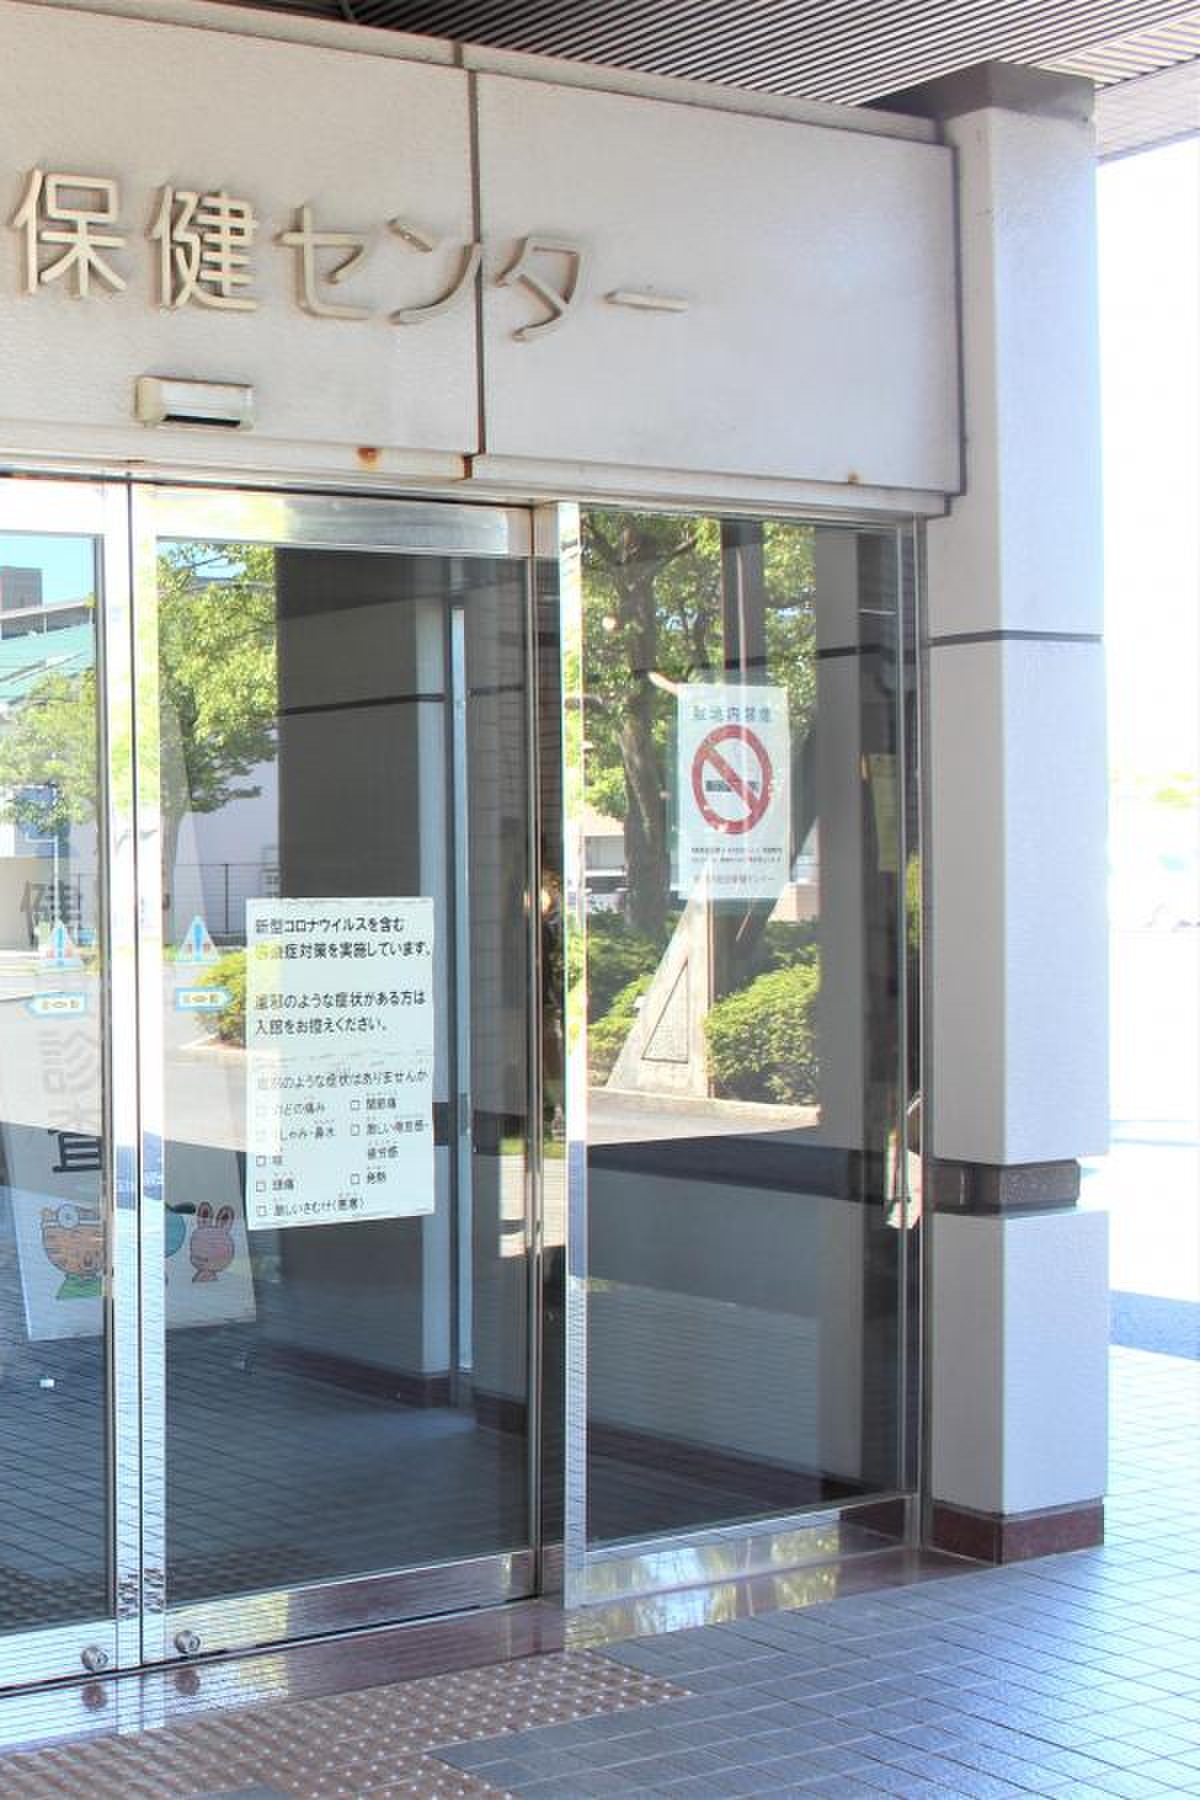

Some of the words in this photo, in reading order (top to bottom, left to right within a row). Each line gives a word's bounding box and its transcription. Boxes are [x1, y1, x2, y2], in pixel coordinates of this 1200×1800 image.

[255, 916, 404, 934] 新型コロナウイルスを含む
[255, 1018, 388, 1035] 入館をお控えください。
[275, 1126, 335, 1142] しゃみ・鼻水
